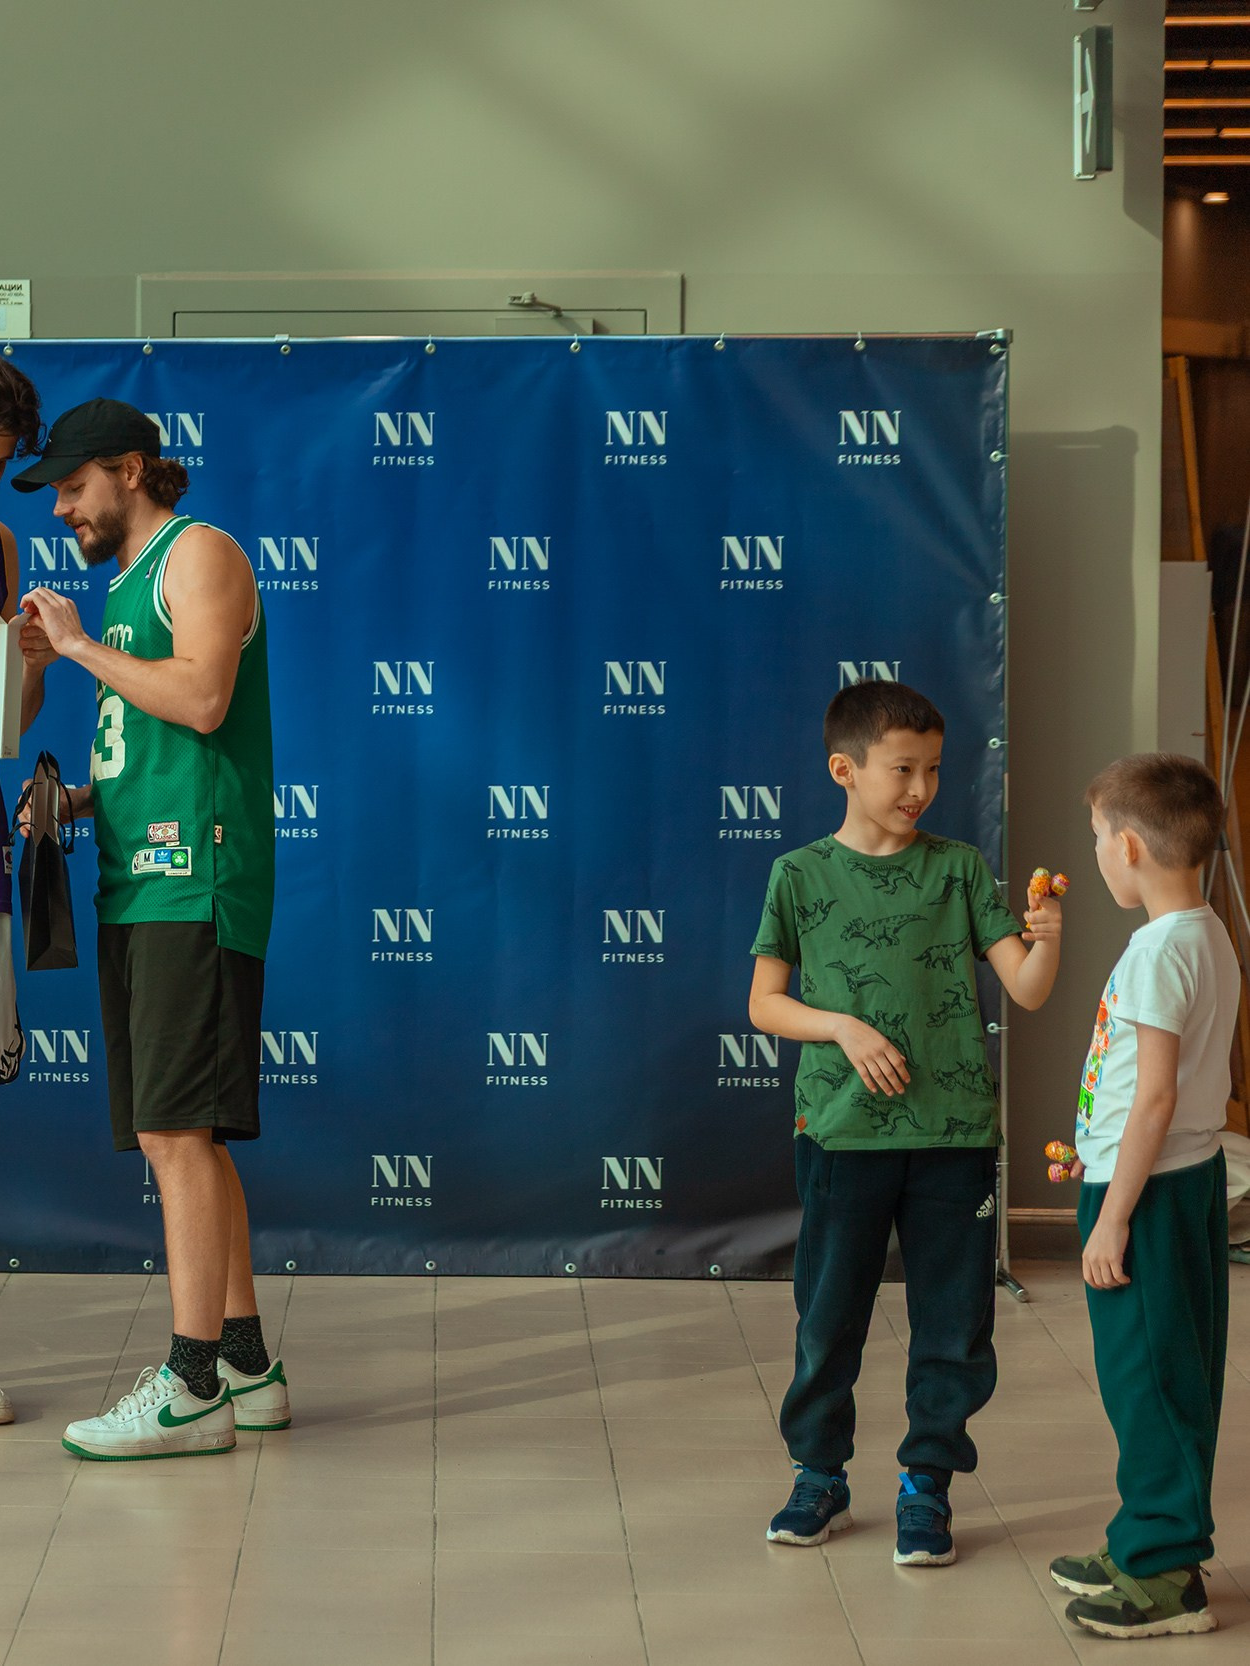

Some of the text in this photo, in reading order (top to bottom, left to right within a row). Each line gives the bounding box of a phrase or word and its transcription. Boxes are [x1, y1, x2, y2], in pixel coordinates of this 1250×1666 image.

[374, 412, 435, 446] NN
[605, 411, 667, 445] NN
[839, 411, 901, 445] NN
[374, 456, 434, 465] FITNESS
[605, 455, 667, 464] FITNESS
[839, 455, 901, 464] FITNESS
[258, 537, 319, 570] NN
[489, 537, 551, 570] NN
[722, 536, 784, 570] NN
[29, 581, 90, 590] FITNESS
[258, 581, 319, 590] FITNESS
[489, 580, 550, 590] FITNESS
[721, 580, 784, 589] FITNESS
[373, 661, 435, 695] NN
[605, 662, 667, 695] NN
[838, 661, 901, 690] NN
[373, 705, 434, 714] FITNESS
[604, 705, 665, 714] FITNESS
[90, 695, 125, 783] 3
[488, 785, 550, 820] NN
[721, 786, 783, 820] NN
[274, 828, 318, 838] TNESS
[487, 829, 549, 838] FITNESS
[720, 830, 782, 839] FITNESS
[372, 909, 434, 943] NN
[603, 909, 665, 943] NN
[372, 952, 433, 962] FITNESS
[603, 953, 664, 963] FITNESS
[29, 1030, 91, 1063] NN
[260, 1031, 319, 1065] NN
[486, 1033, 549, 1066] NN
[718, 1033, 781, 1067] NN
[29, 1073, 90, 1082] FITNESS
[259, 1074, 318, 1084] FITNESS
[486, 1076, 548, 1085] FITNESS
[718, 1077, 780, 1087] FITNESS
[371, 1155, 433, 1188] NN
[602, 1156, 664, 1190] NN
[371, 1197, 432, 1207] FITNESS
[601, 1200, 663, 1209] FITNESS
